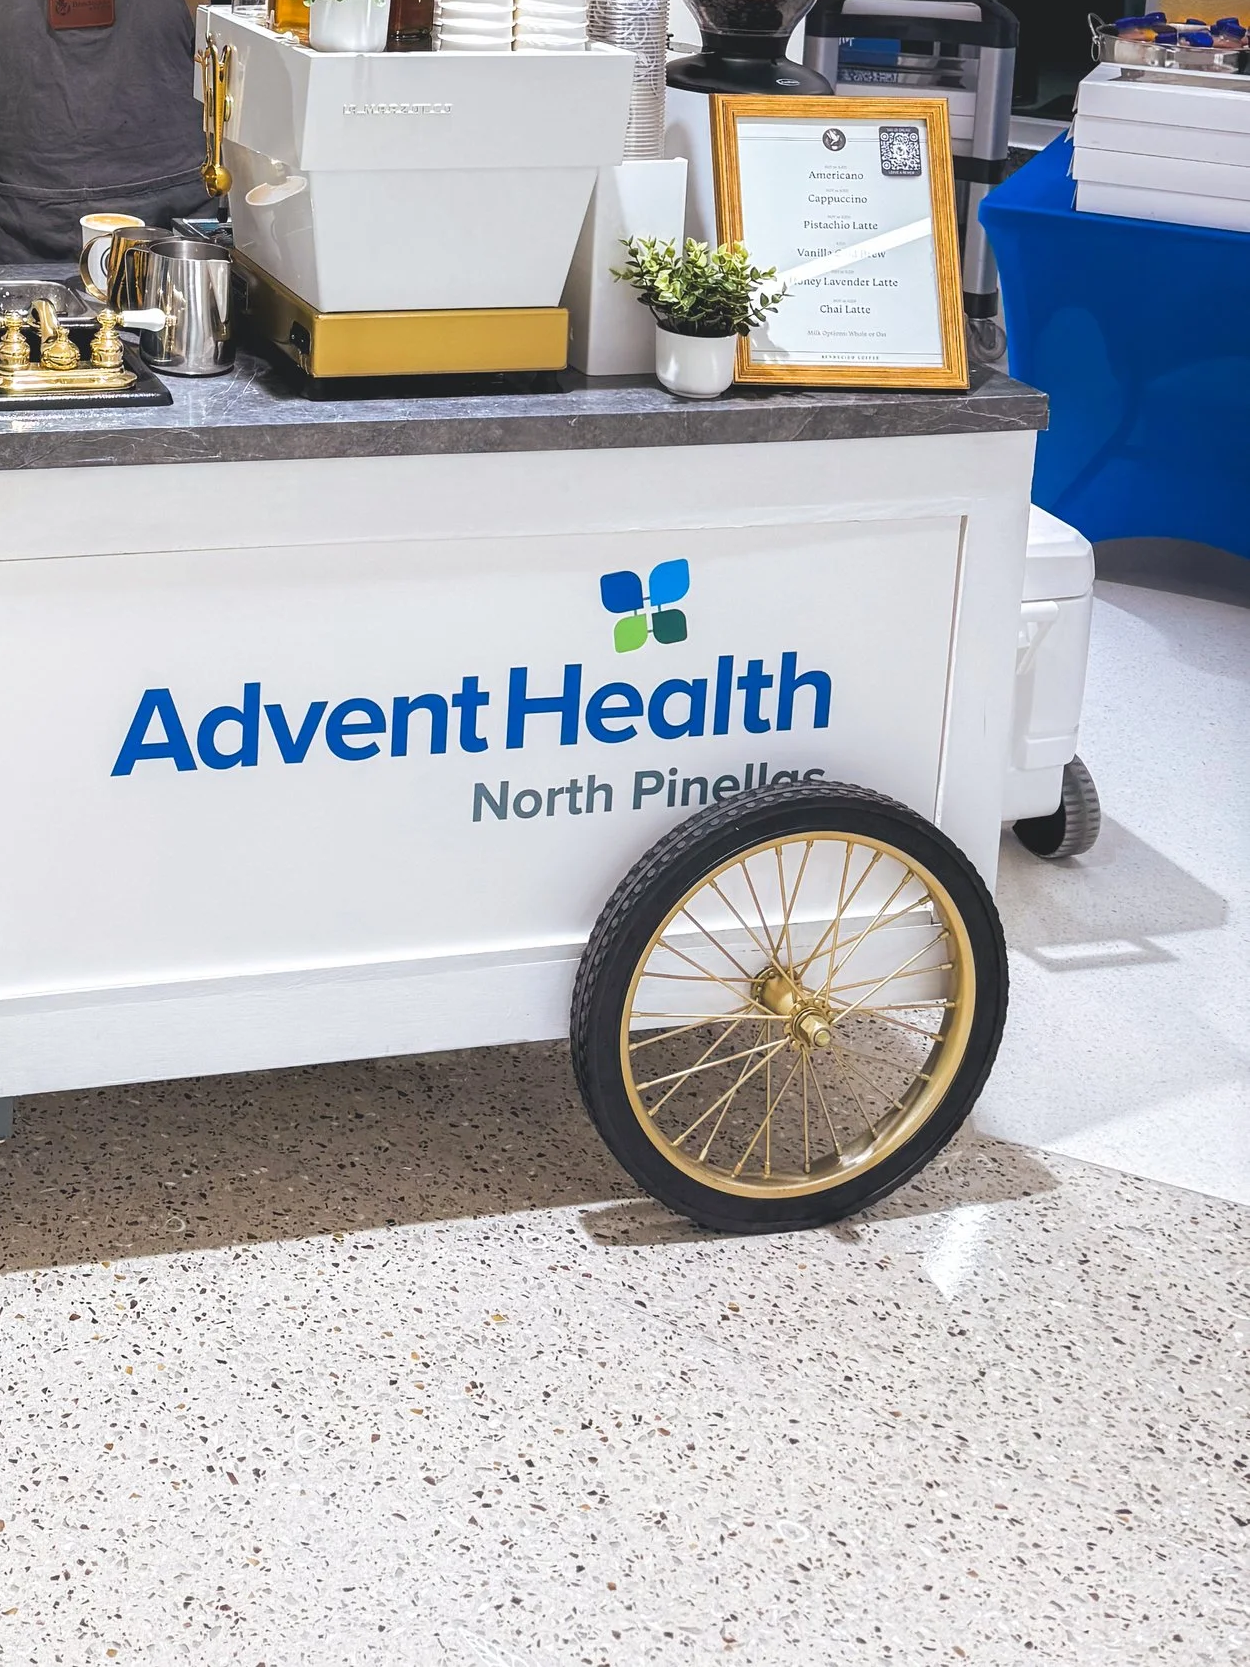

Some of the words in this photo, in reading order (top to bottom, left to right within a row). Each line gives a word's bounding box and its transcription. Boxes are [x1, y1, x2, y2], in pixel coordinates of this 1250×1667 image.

[808, 171, 864, 180] Americano
[808, 194, 868, 205] Cappuccino
[803, 220, 850, 230] Pistachio
[852, 221, 878, 230] Latte
[797, 248, 832, 258] Vanilla
[823, 277, 870, 287] Lavender
[872, 278, 899, 287] Latte
[819, 304, 843, 314] Chai
[845, 304, 871, 314] Latte
[472, 773, 613, 823] North
